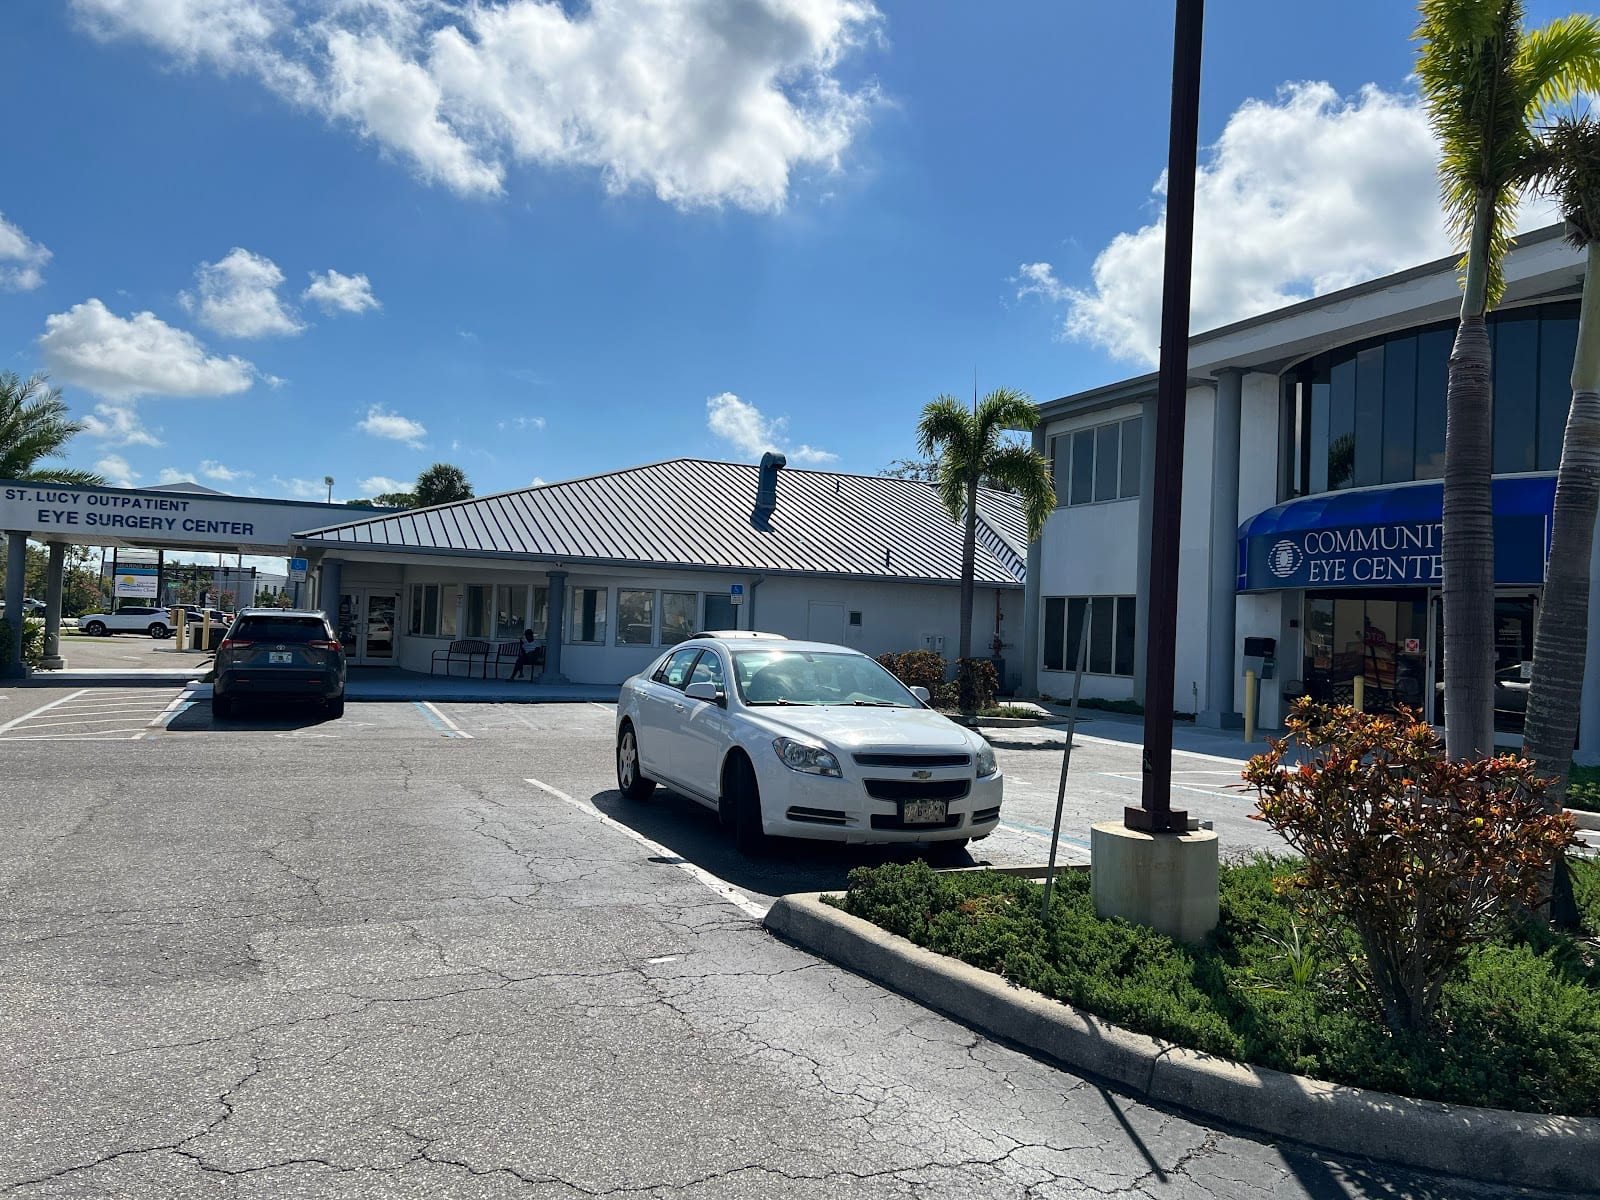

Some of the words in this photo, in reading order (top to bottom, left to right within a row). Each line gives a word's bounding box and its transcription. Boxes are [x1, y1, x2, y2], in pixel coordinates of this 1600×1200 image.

[5, 488, 32, 501] ST.
[36, 491, 81, 504] LUCY
[87, 494, 190, 512] OUTPATIENT
[37, 509, 79, 525] EYE
[85, 512, 177, 531] SURGERY
[182, 518, 254, 536] CENTER
[1304, 524, 1443, 554] COMMUNI
[1309, 559, 1346, 582] EYE
[1352, 555, 1443, 580] CENTE
